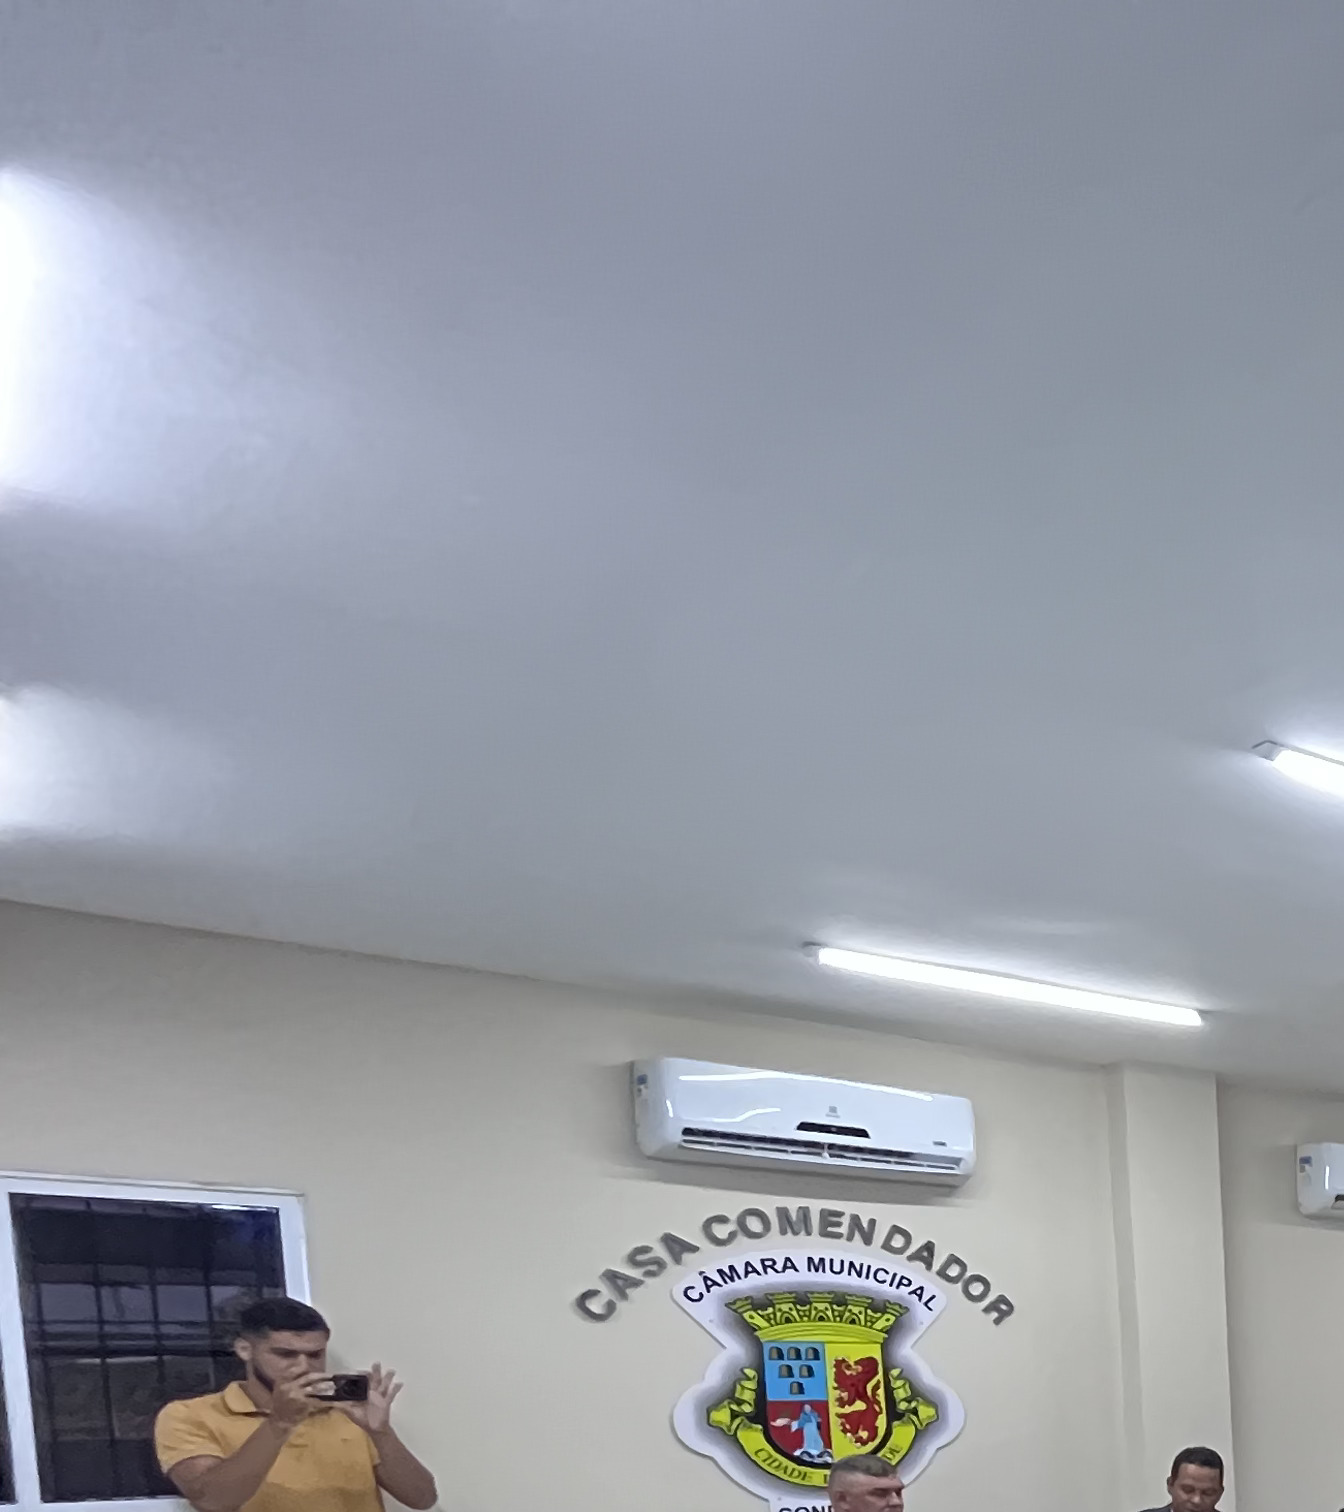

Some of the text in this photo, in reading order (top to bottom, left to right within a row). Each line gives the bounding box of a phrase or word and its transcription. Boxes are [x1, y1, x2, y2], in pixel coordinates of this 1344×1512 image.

[574, 1206, 1015, 1326] CASA COMENDADOR
[683, 1256, 937, 1312] CÂMARA MUNICIPAL
[754, 1447, 812, 1483] CIDADE
